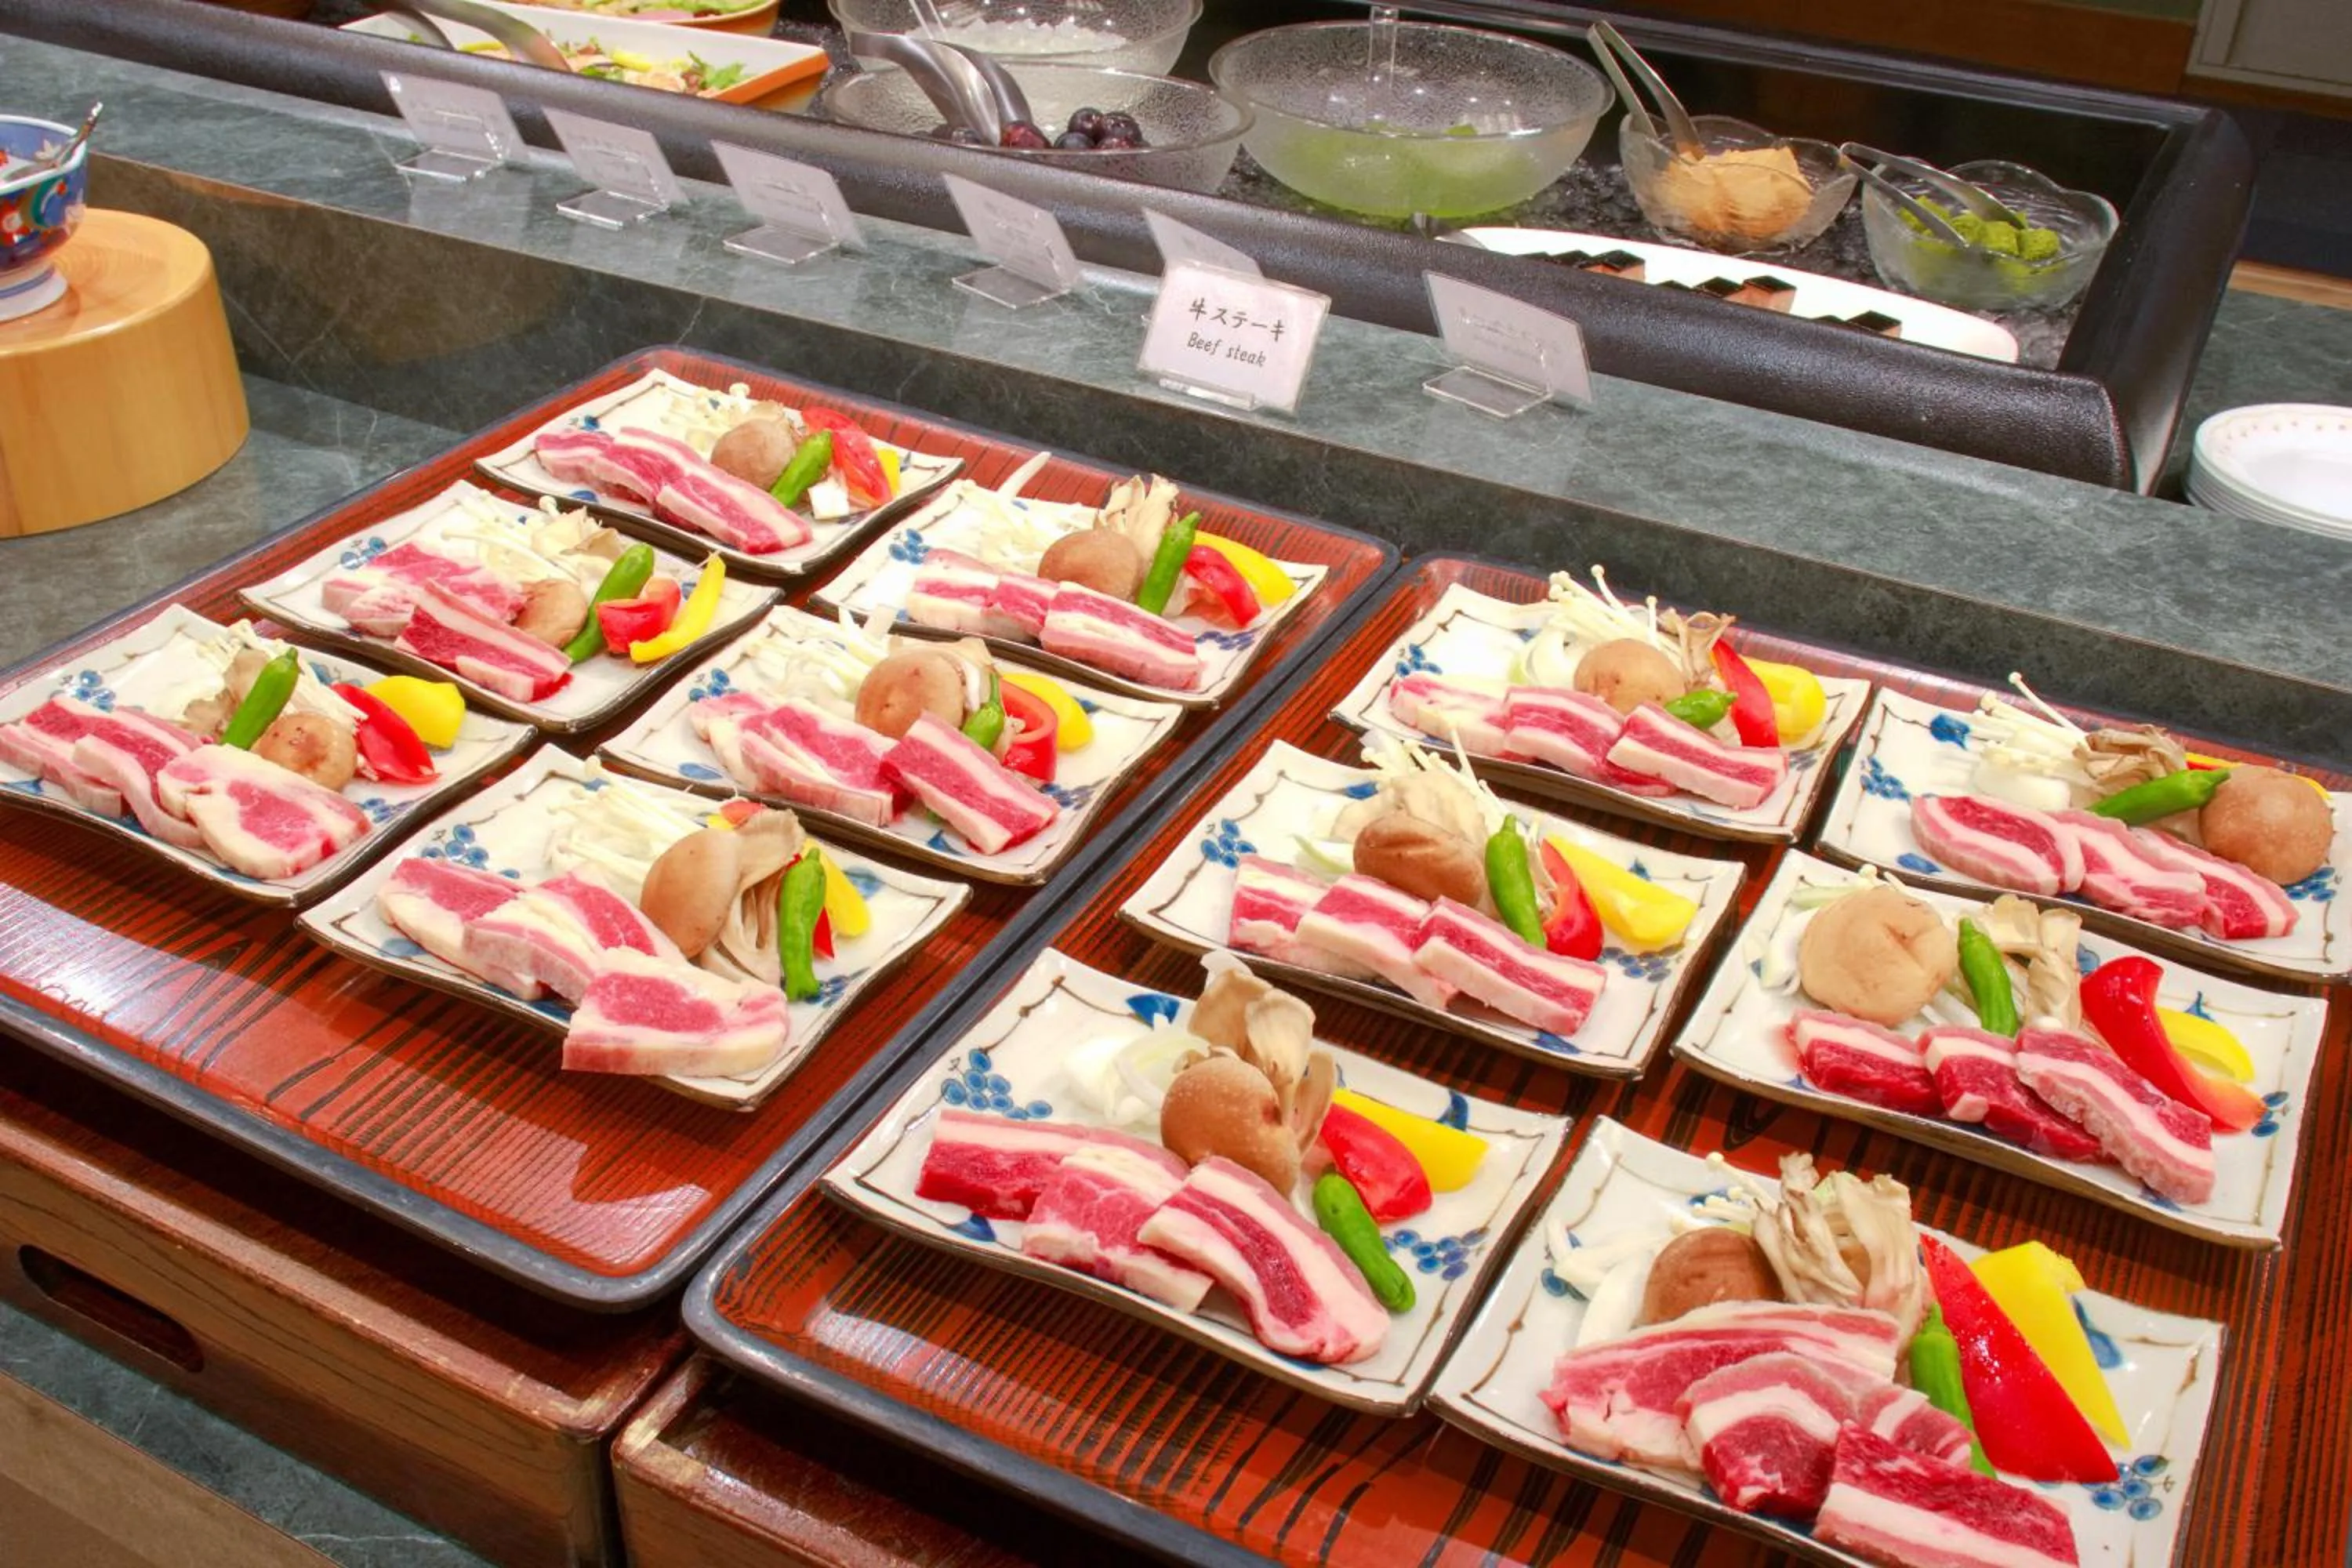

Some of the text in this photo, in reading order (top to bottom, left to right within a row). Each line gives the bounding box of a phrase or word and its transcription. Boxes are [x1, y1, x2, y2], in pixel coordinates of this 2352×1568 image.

[1189, 297, 1286, 343] 牛ステーキ
[1187, 331, 1267, 367] Beef steak
